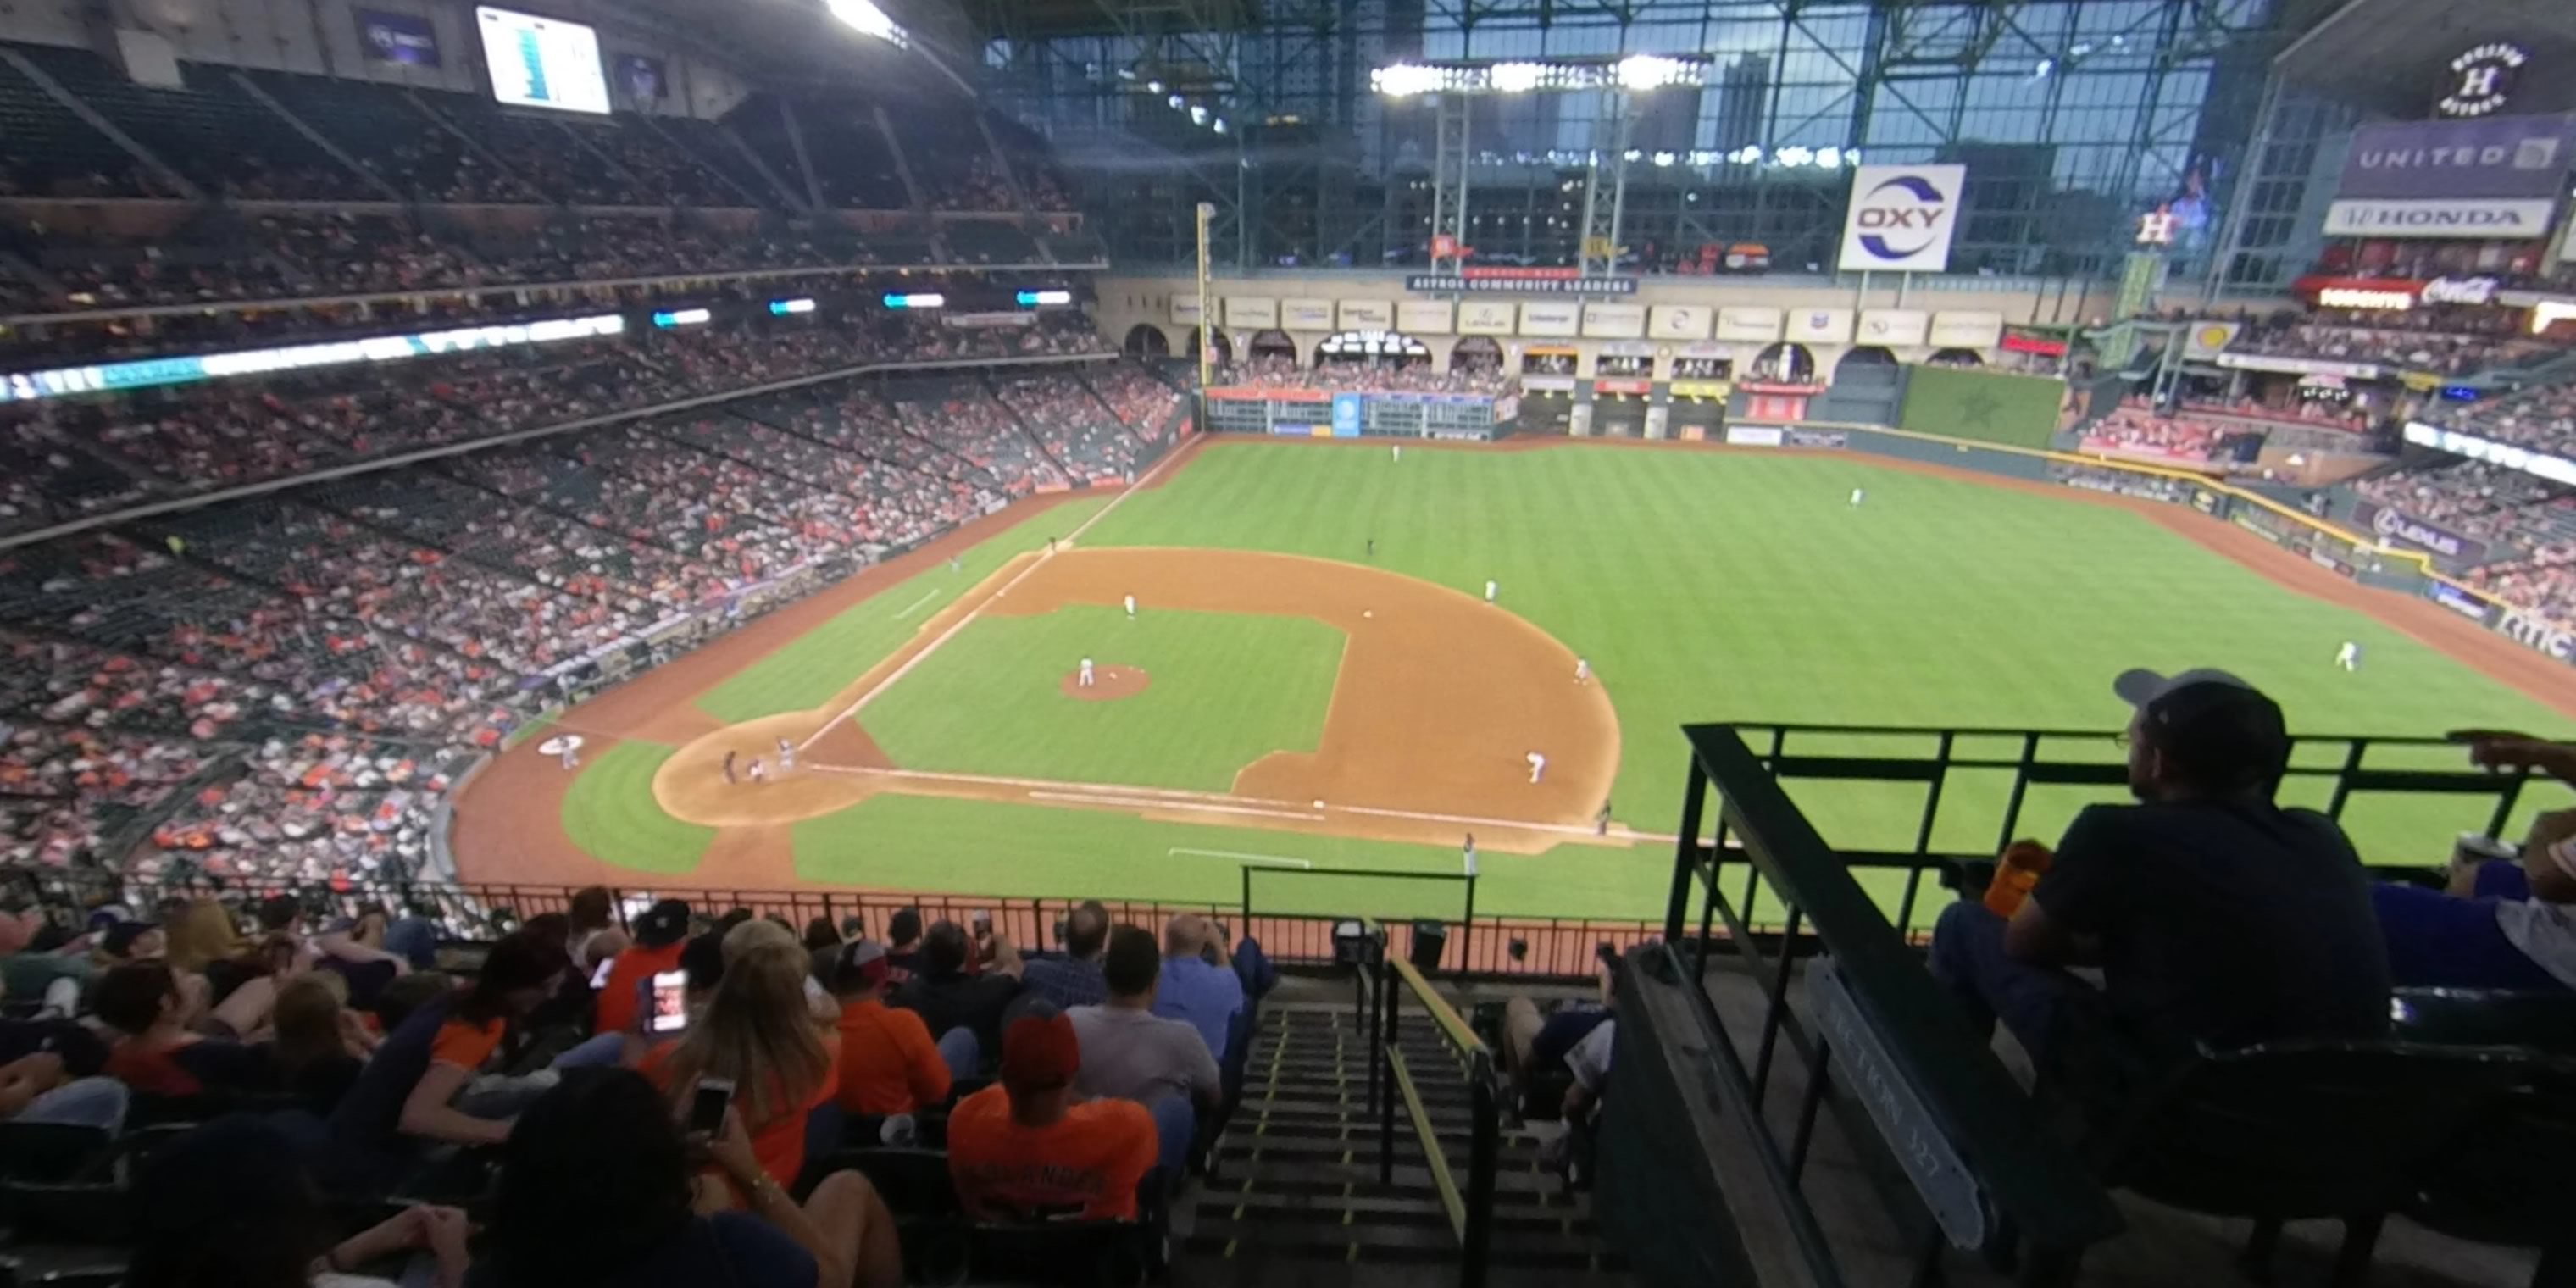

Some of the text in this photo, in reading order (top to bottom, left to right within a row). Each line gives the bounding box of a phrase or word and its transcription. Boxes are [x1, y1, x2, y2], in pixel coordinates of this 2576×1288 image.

[2459, 65, 2499, 96] H
[2360, 146, 2506, 169] UNITED
[1857, 208, 1945, 229] OXY
[2379, 208, 2522, 226] HONDA
[1413, 278, 1630, 293] ASTROS COMMUNITY LEADERS
[2397, 518, 2459, 555] LEXUS
[2501, 611, 2573, 658] RTIC
[1910, 1128, 1940, 1179] 327
